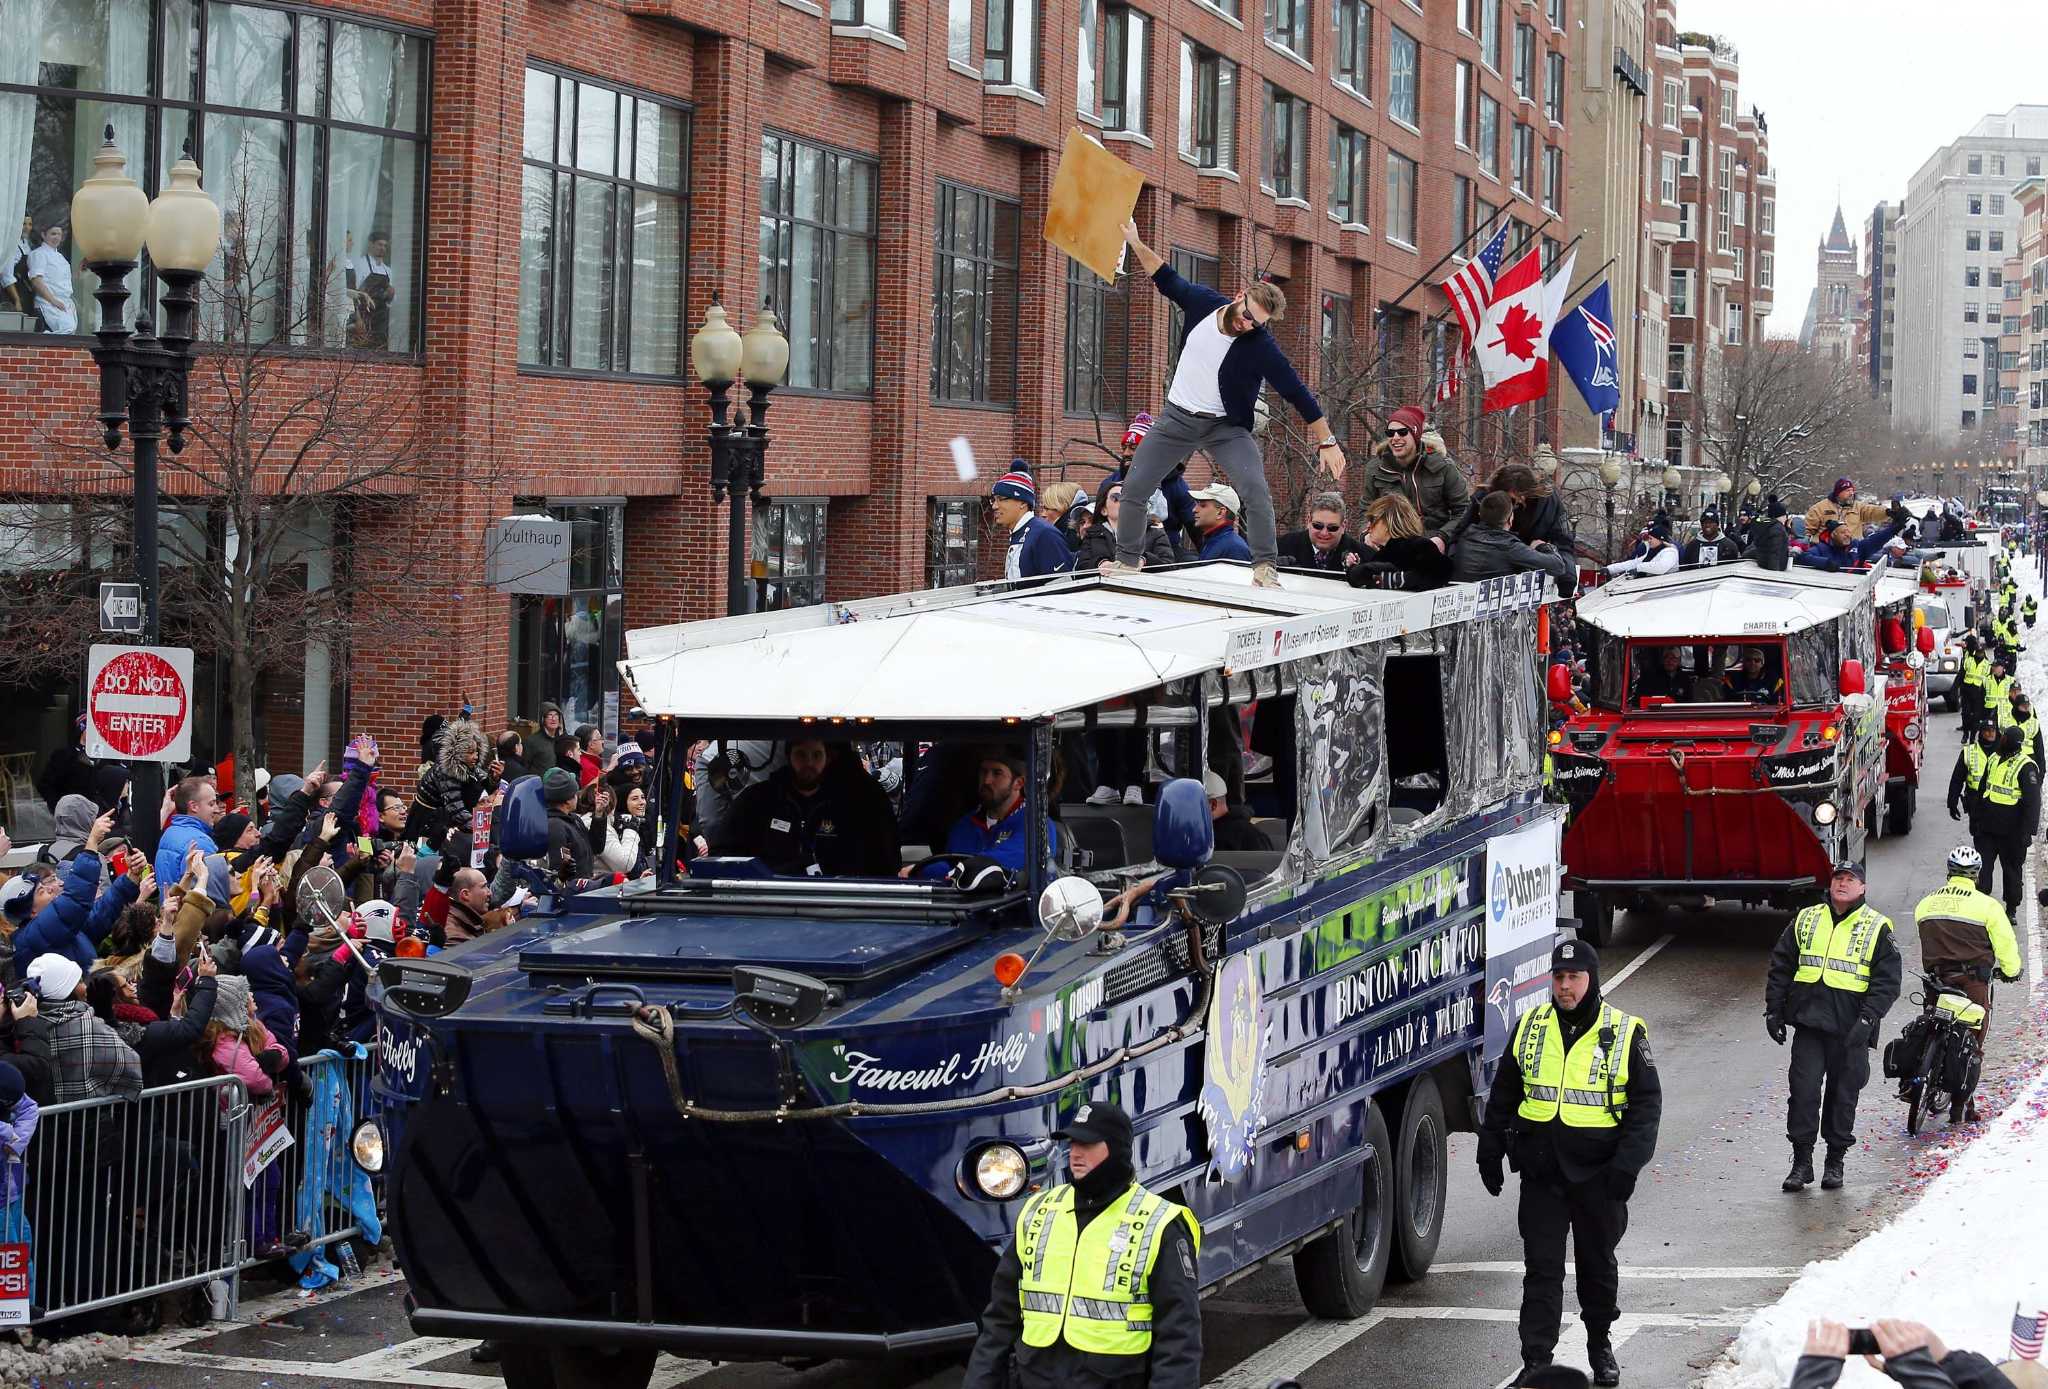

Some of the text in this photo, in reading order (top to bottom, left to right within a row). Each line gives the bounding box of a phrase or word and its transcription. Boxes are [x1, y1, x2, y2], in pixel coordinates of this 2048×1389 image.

[504, 527, 562, 548] bulthaup
[112, 599, 137, 616] ONE WAY
[1352, 609, 1368, 625] TICKETS
[1283, 630, 1309, 650] Museum
[1317, 624, 1340, 644] Science
[1743, 621, 1777, 630] CHARTER
[1236, 631, 1256, 649] TICKETS
[1231, 649, 1263, 671] DEPARTURES
[104, 672, 175, 693] DO NOT
[110, 715, 165, 735] ENTER
[1771, 765, 1795, 779] "Miss
[1797, 762, 1821, 778] Emma
[1504, 863, 1551, 911] Putnam
[1507, 902, 1552, 933] INVESTMENTS
[1335, 954, 1401, 1024] BOSTON
[1410, 931, 1451, 989] DUCK
[1376, 1021, 1414, 1068] LAND
[1419, 1014, 1429, 1047] &
[1434, 995, 1475, 1040] WATER
[1525, 1014, 1544, 1071] BOSTON
[381, 1025, 423, 1084] Holly"
[829, 1031, 1036, 1091] "Faneuil Holly"
[1117, 1209, 1150, 1287] POLICE
